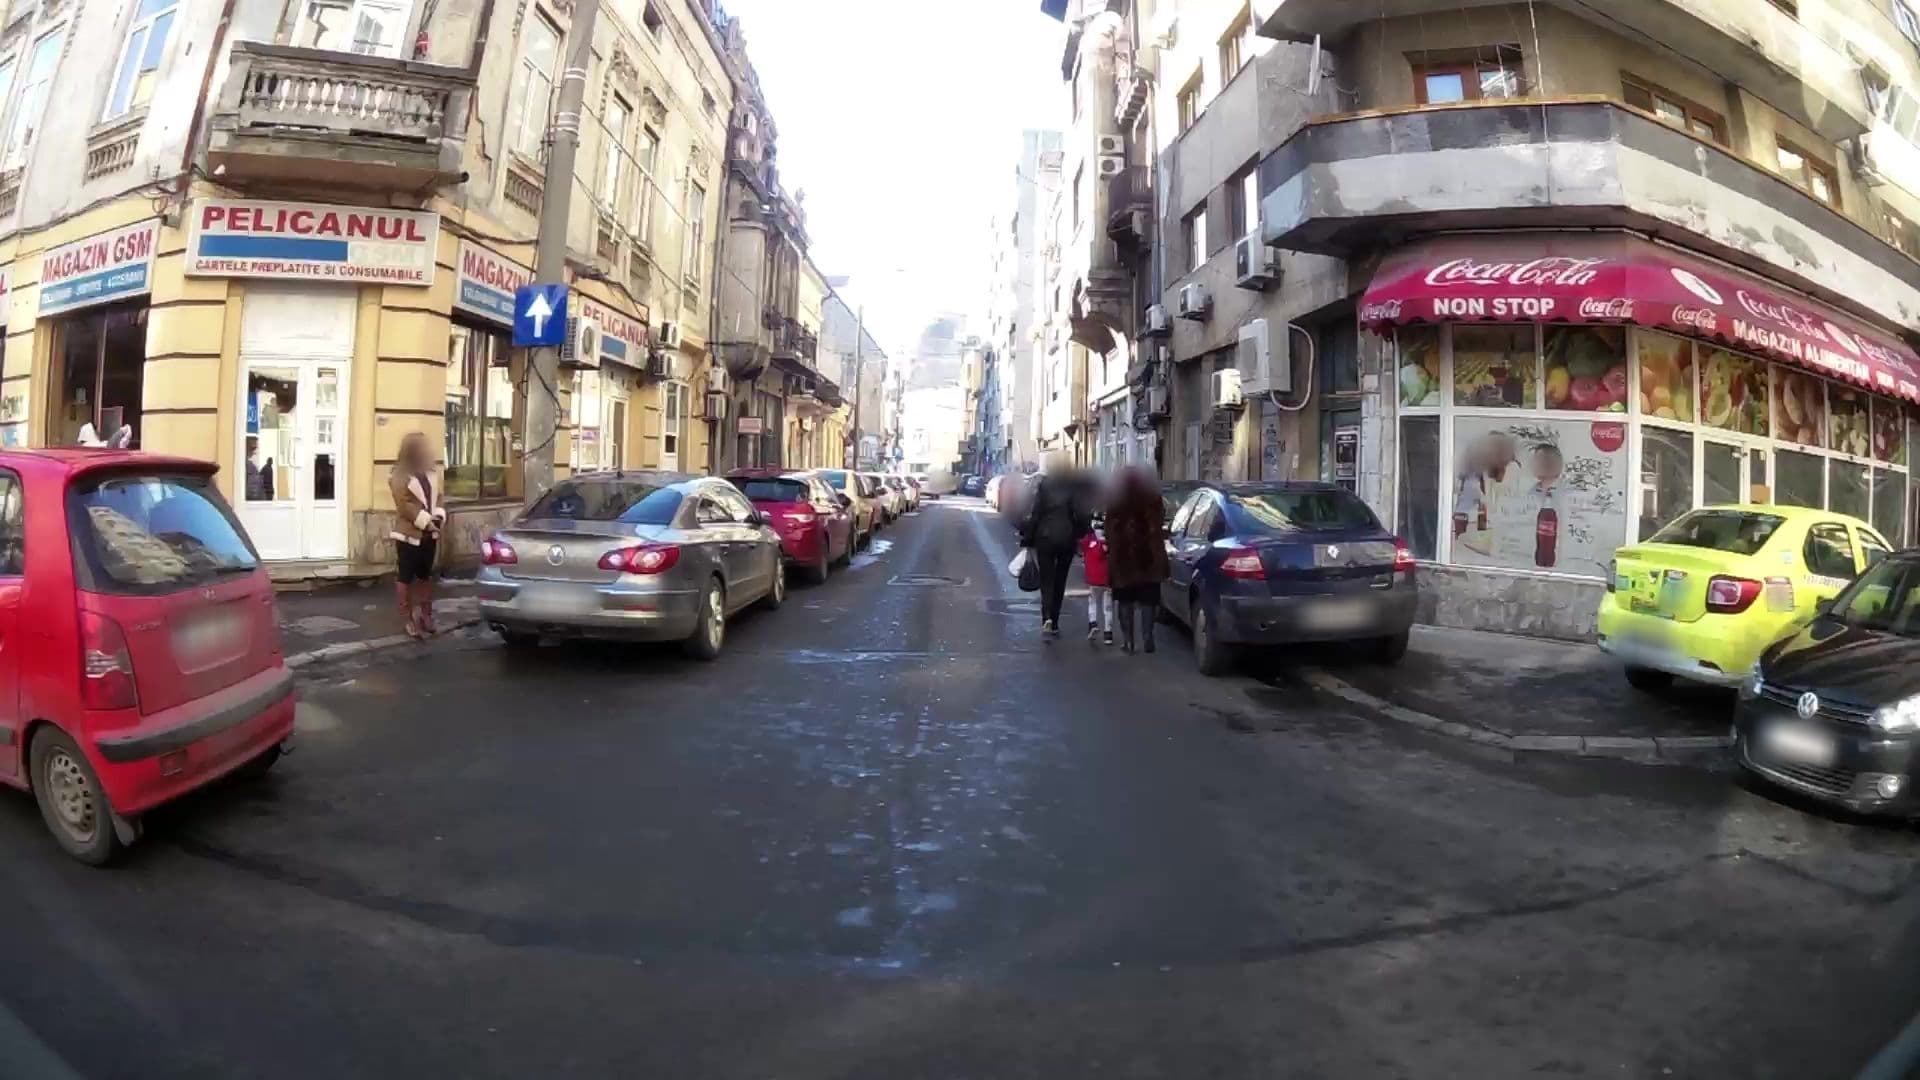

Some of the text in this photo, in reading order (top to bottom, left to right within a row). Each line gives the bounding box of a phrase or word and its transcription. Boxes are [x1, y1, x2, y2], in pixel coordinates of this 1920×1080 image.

[201, 206, 426, 242] PELICANUL
[42, 229, 153, 284] MAGAZIN GSM
[195, 260, 423, 281] CARTELE PREPLATITE SI CONSUMABILE
[1433, 297, 1555, 316] NON STOP
[1733, 319, 1803, 358] MAGAZIN
